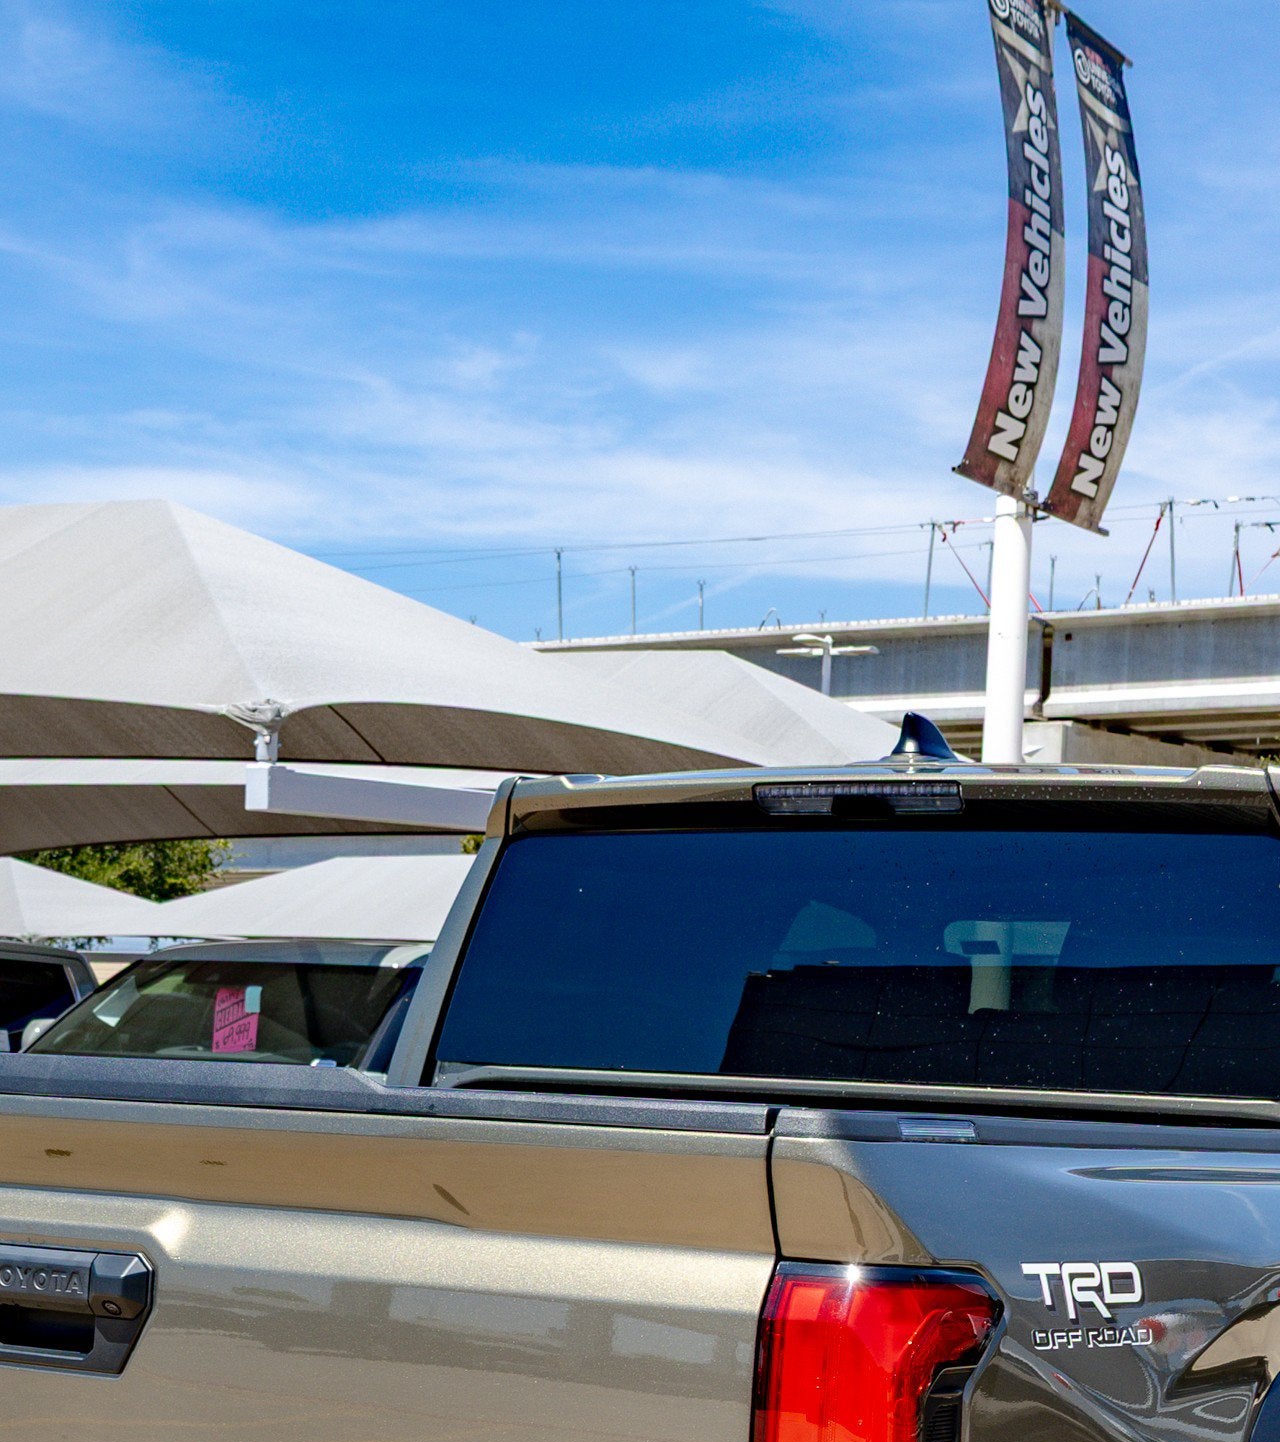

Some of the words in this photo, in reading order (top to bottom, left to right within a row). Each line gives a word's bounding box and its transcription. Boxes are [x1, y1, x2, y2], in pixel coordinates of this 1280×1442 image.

[987, 331, 1043, 463] New
[1017, 83, 1052, 321] Vehicles
[1070, 377, 1123, 499] New
[1098, 144, 1132, 365] Vehicles
[1020, 1261, 1144, 1324] TRD
[1031, 1327, 1083, 1350] OFF
[1085, 1326, 1153, 1349] ROAD
